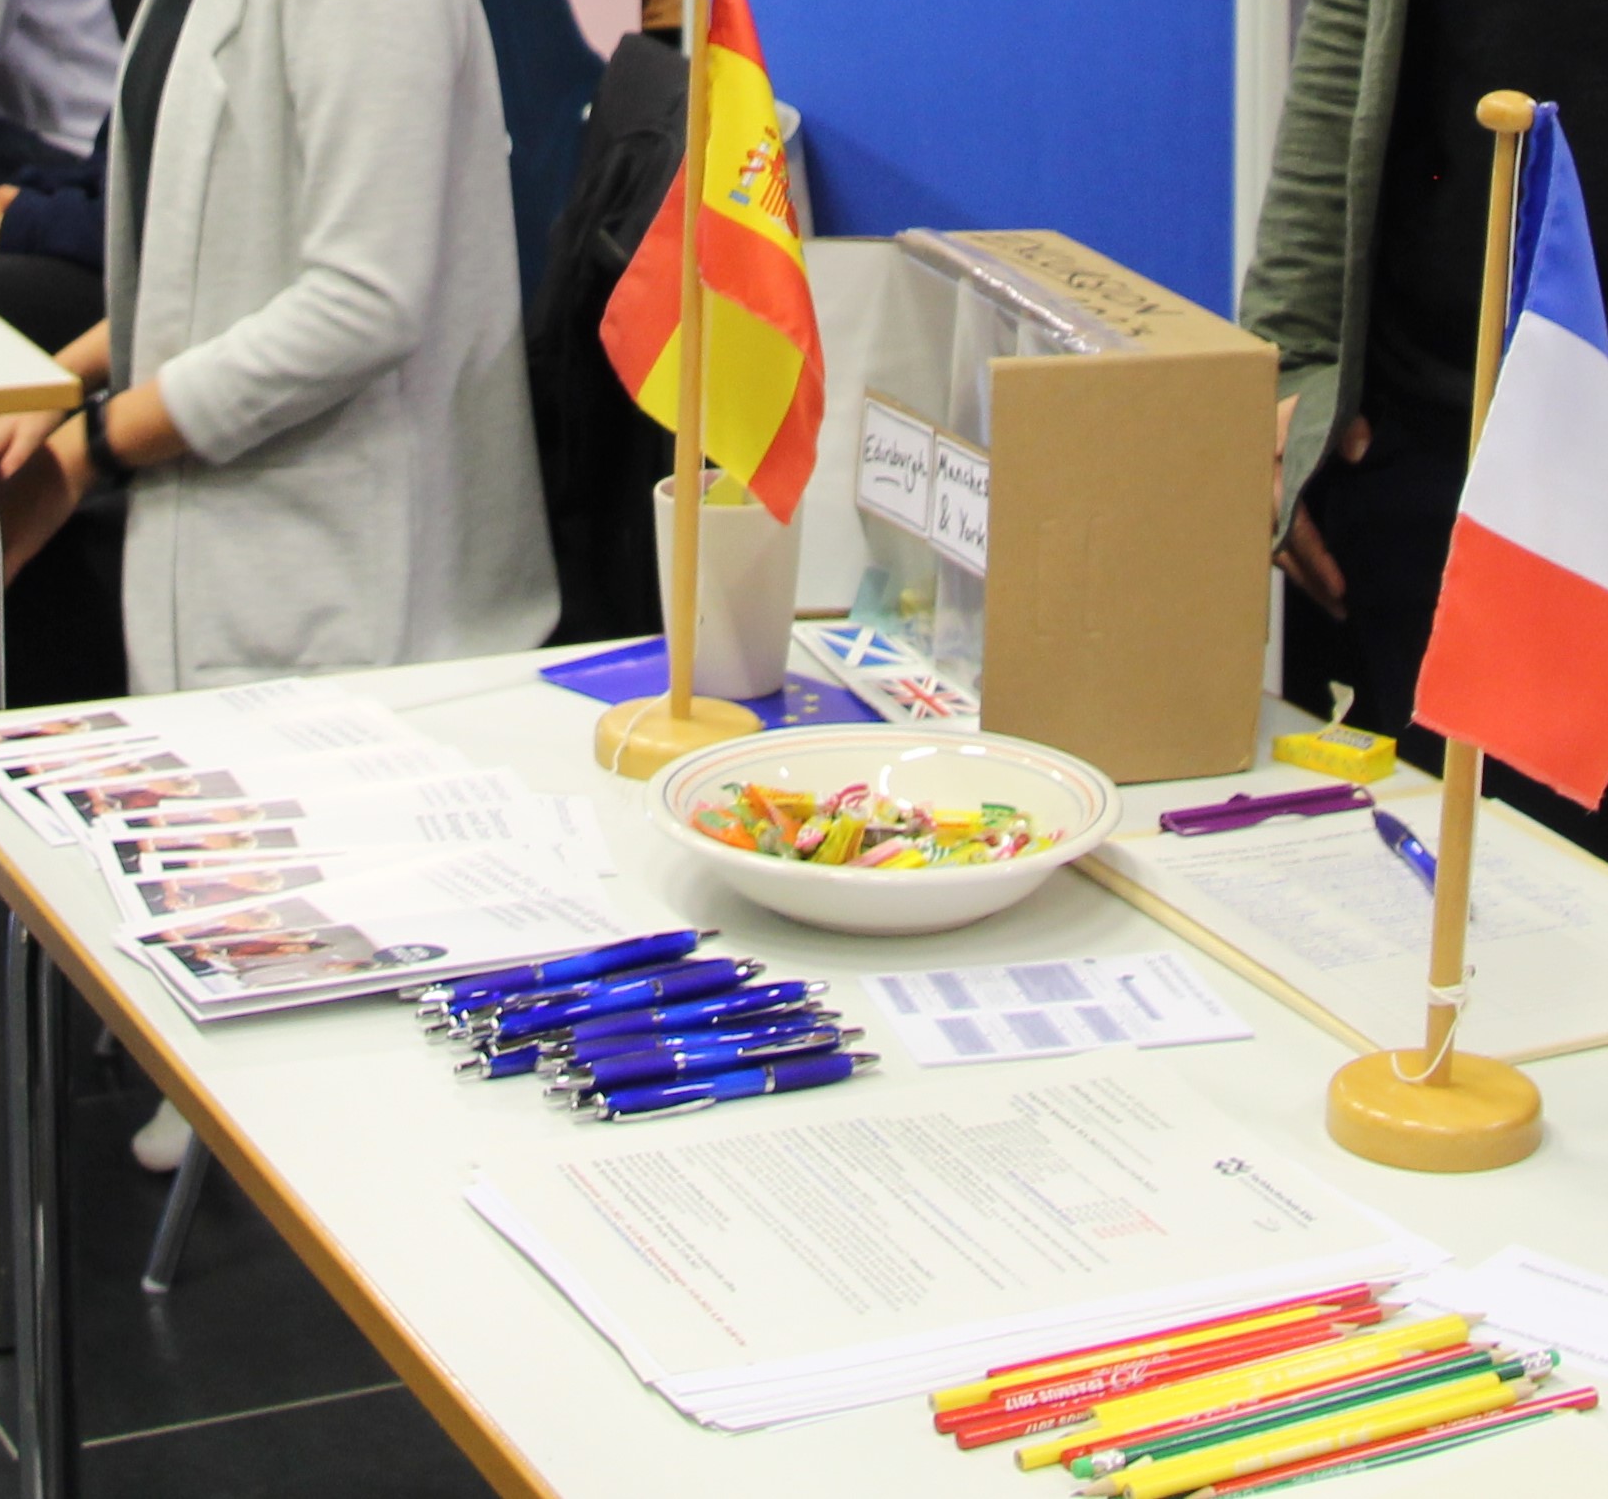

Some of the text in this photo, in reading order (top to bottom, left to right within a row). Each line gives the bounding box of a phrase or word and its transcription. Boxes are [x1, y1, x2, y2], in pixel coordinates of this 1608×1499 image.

[939, 493, 986, 551] & York
[1004, 1391, 1036, 1412] 2017
[1038, 1377, 1105, 1404] ERASMUS
